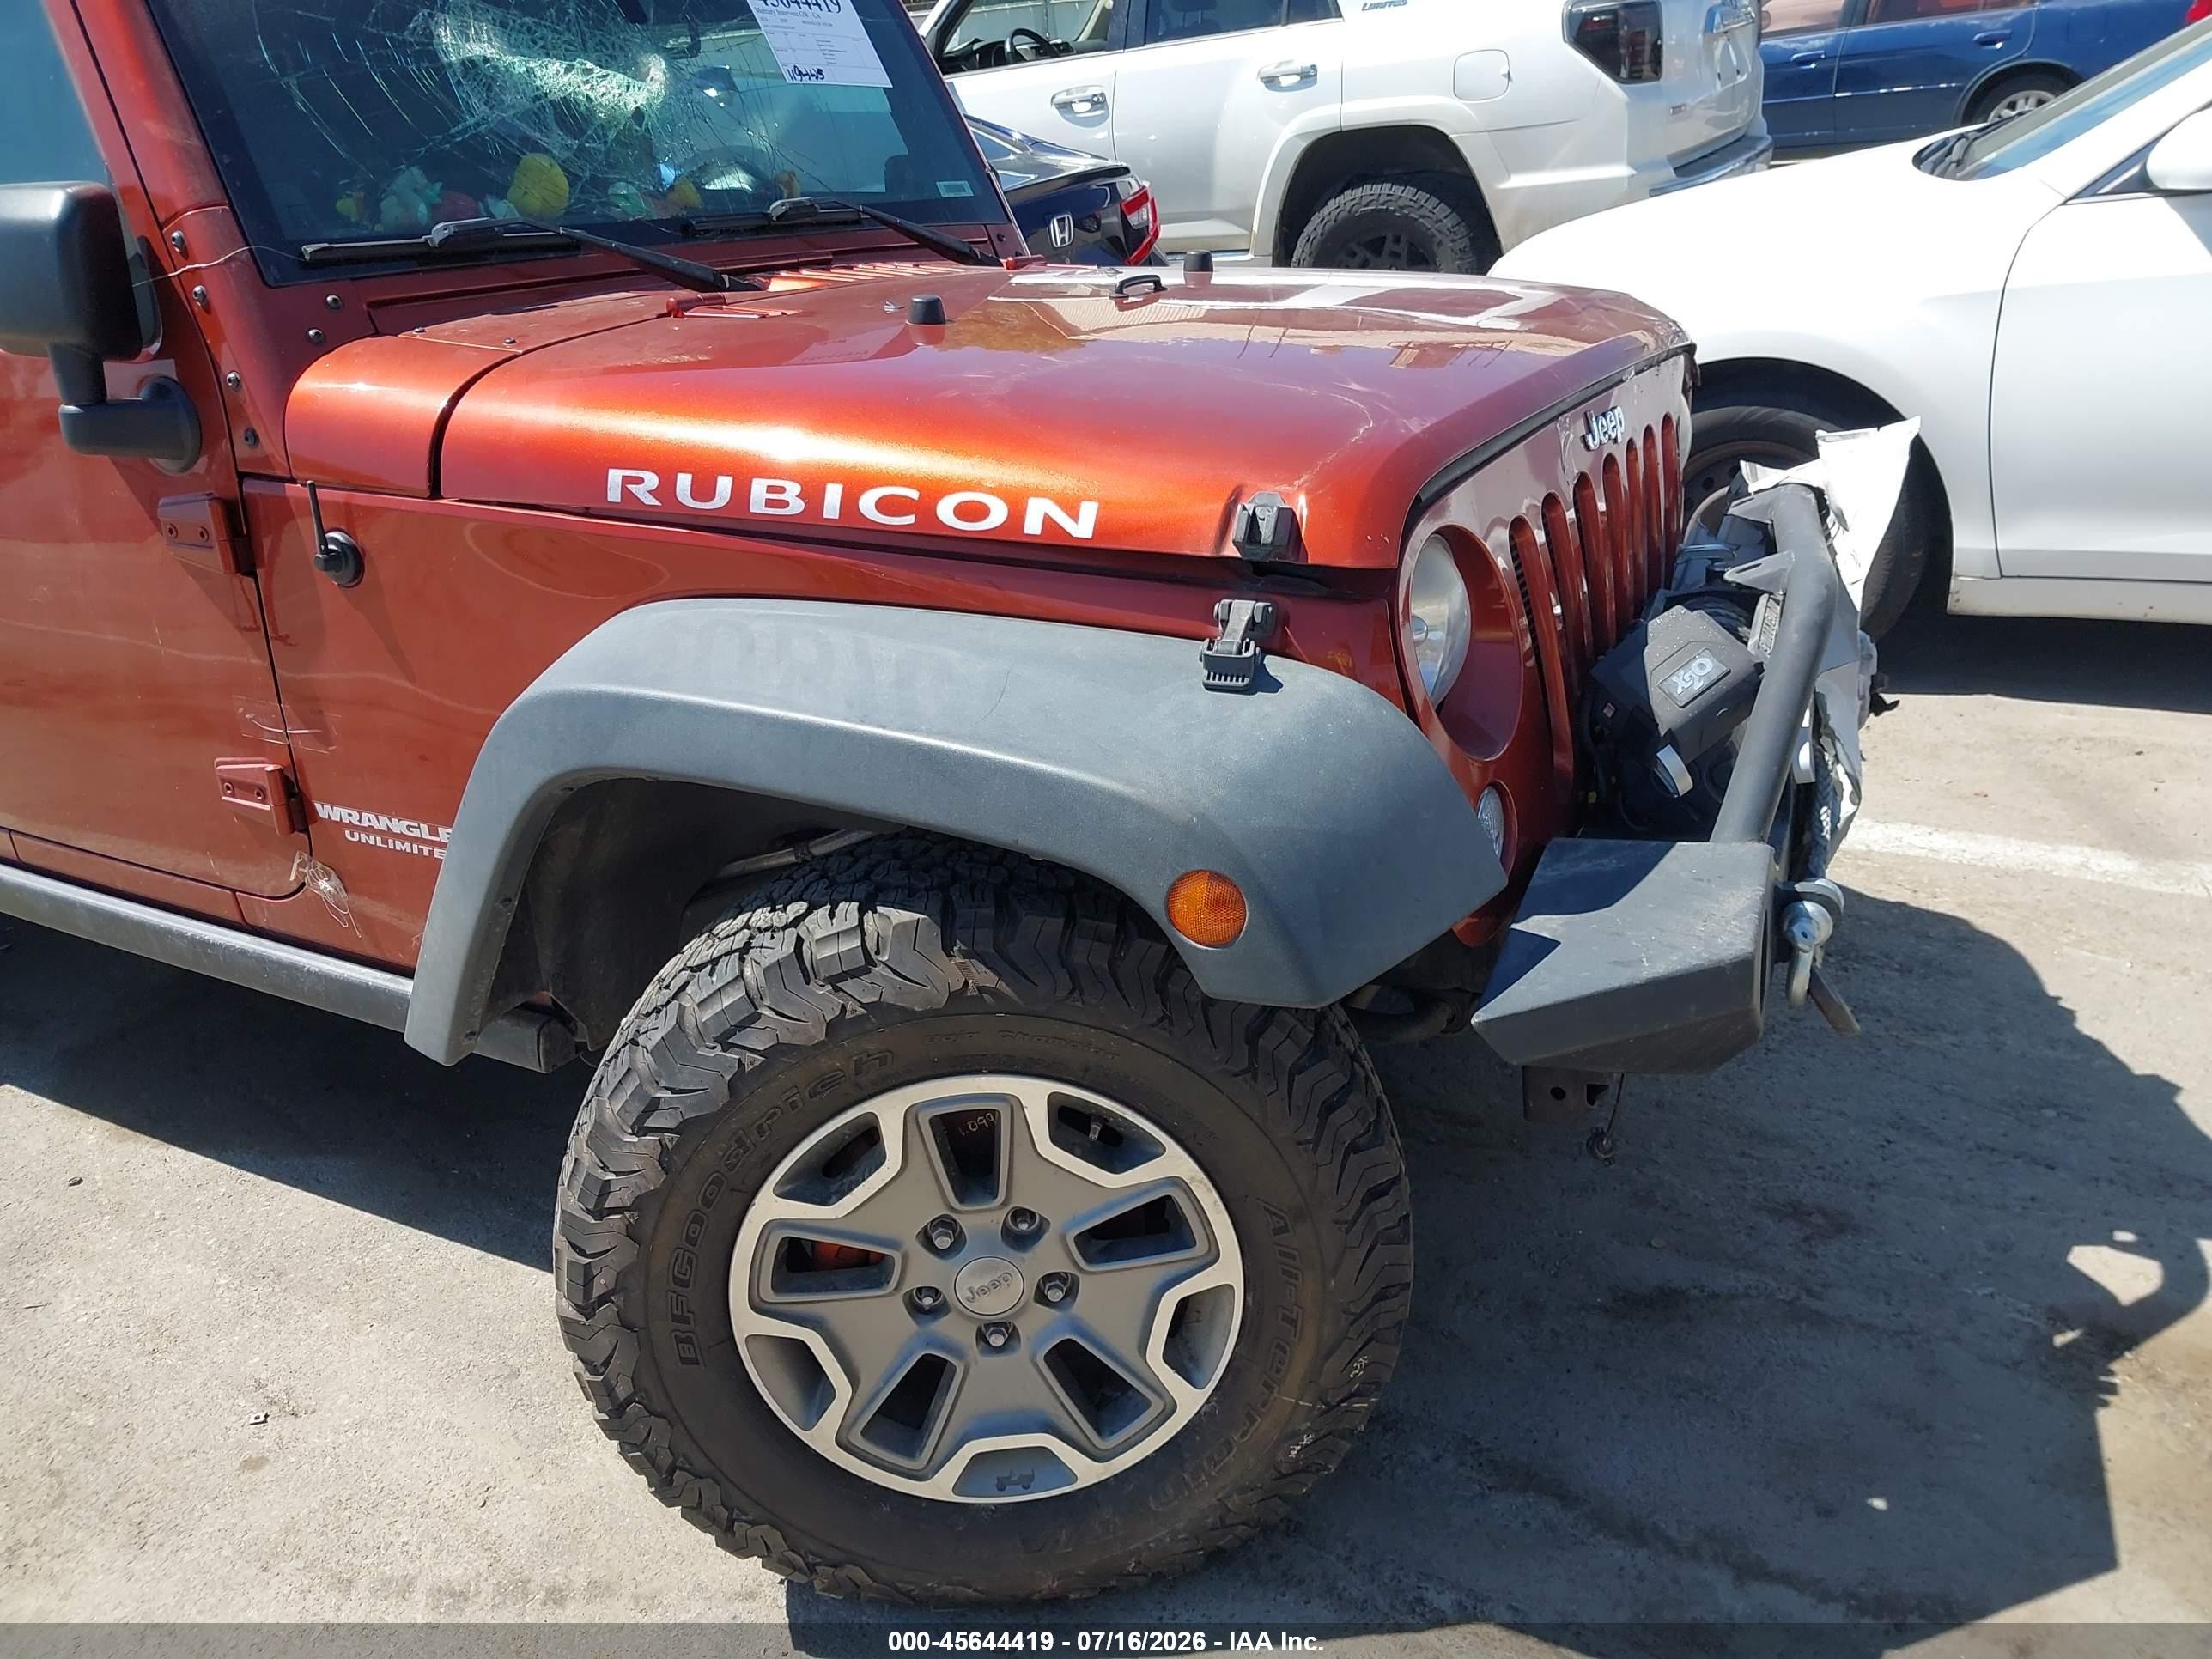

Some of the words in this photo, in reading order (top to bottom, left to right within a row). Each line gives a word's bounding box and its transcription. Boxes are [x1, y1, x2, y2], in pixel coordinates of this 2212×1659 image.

[1583, 405, 1625, 450] Jeep
[606, 468, 1099, 539] RUBICON
[666, 1049, 895, 1368] BFGoodrich
[965, 1272, 1014, 1304] Jeep
